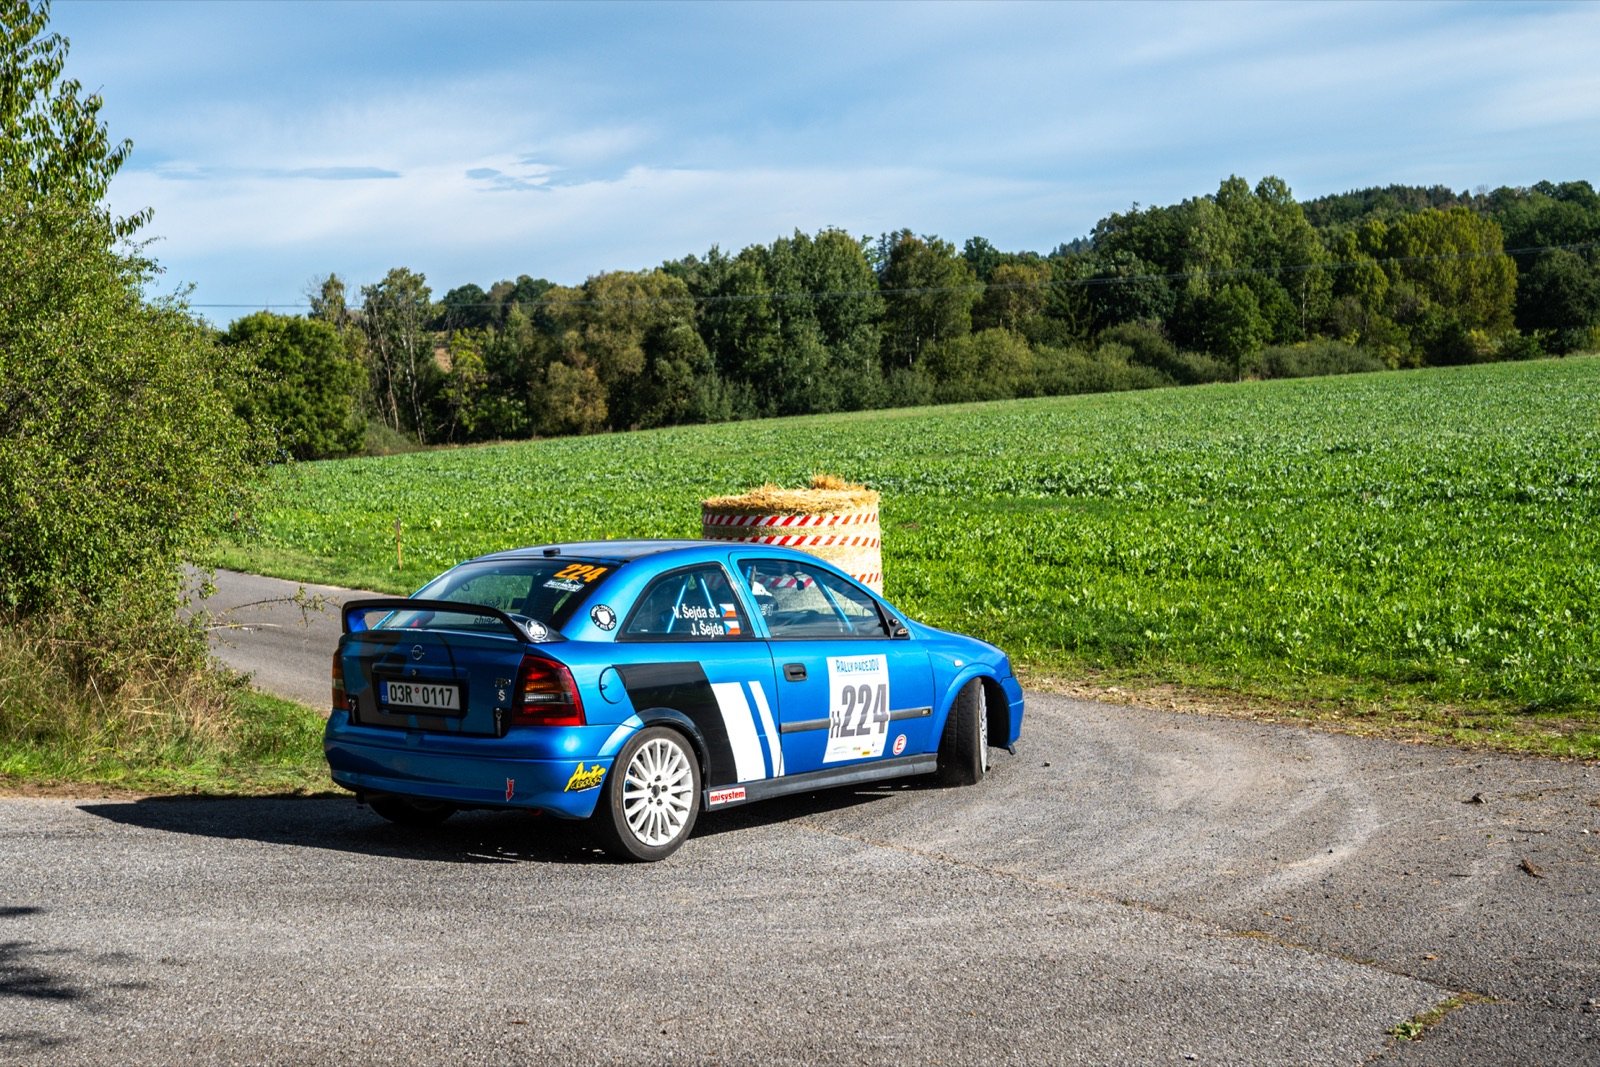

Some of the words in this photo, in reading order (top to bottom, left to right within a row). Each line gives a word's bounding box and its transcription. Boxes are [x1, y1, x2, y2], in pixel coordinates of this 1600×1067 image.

[553, 563, 608, 583] 224
[672, 606, 682, 619] V.
[682, 603, 707, 621] Šejda
[708, 606, 720, 618] st.
[690, 623, 700, 636] J.
[699, 620, 724, 638] Šejda
[836, 659, 853, 673] RALLY
[389, 684, 412, 703] 03R
[421, 687, 453, 706] 0117
[840, 684, 889, 738] 224
